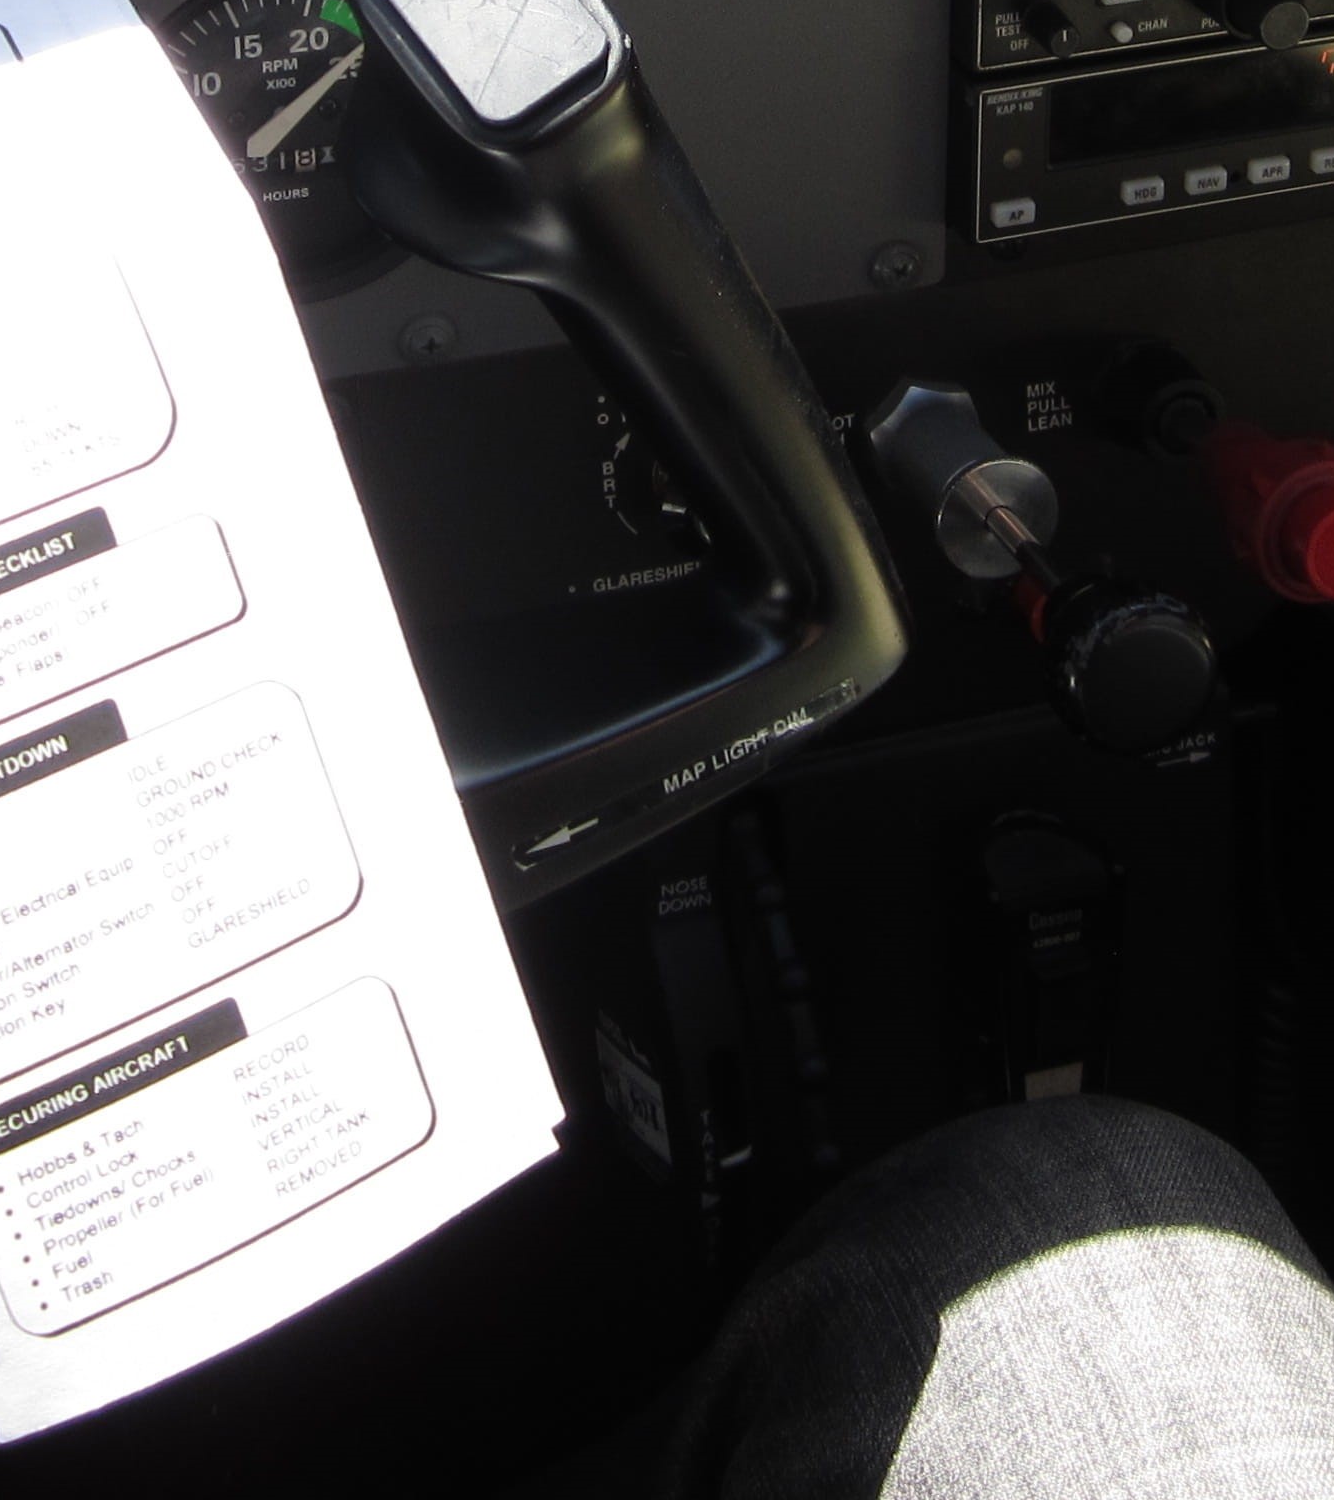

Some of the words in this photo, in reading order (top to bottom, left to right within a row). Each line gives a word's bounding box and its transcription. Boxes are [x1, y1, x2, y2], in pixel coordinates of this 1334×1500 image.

[1137, 17, 1168, 33] CHAN
[234, 34, 262, 59] 15
[289, 27, 329, 54] 20
[262, 58, 298, 74] RPM
[193, 72, 222, 97] 10
[1198, 175, 1219, 190] NAV
[1262, 164, 1285, 179] APR
[263, 188, 310, 203] HOURS
[1026, 381, 1056, 399] MIX
[1027, 395, 1071, 414] PULL
[1027, 412, 1073, 432] LEAN
[662, 760, 707, 794] MAP
[93, 1036, 189, 1094] AIRCRAFT
[18, 1150, 78, 1187] Hobbs
[25, 1170, 92, 1211] Control
[43, 1207, 125, 1257] Propeller
[61, 1269, 115, 1303] Trash
